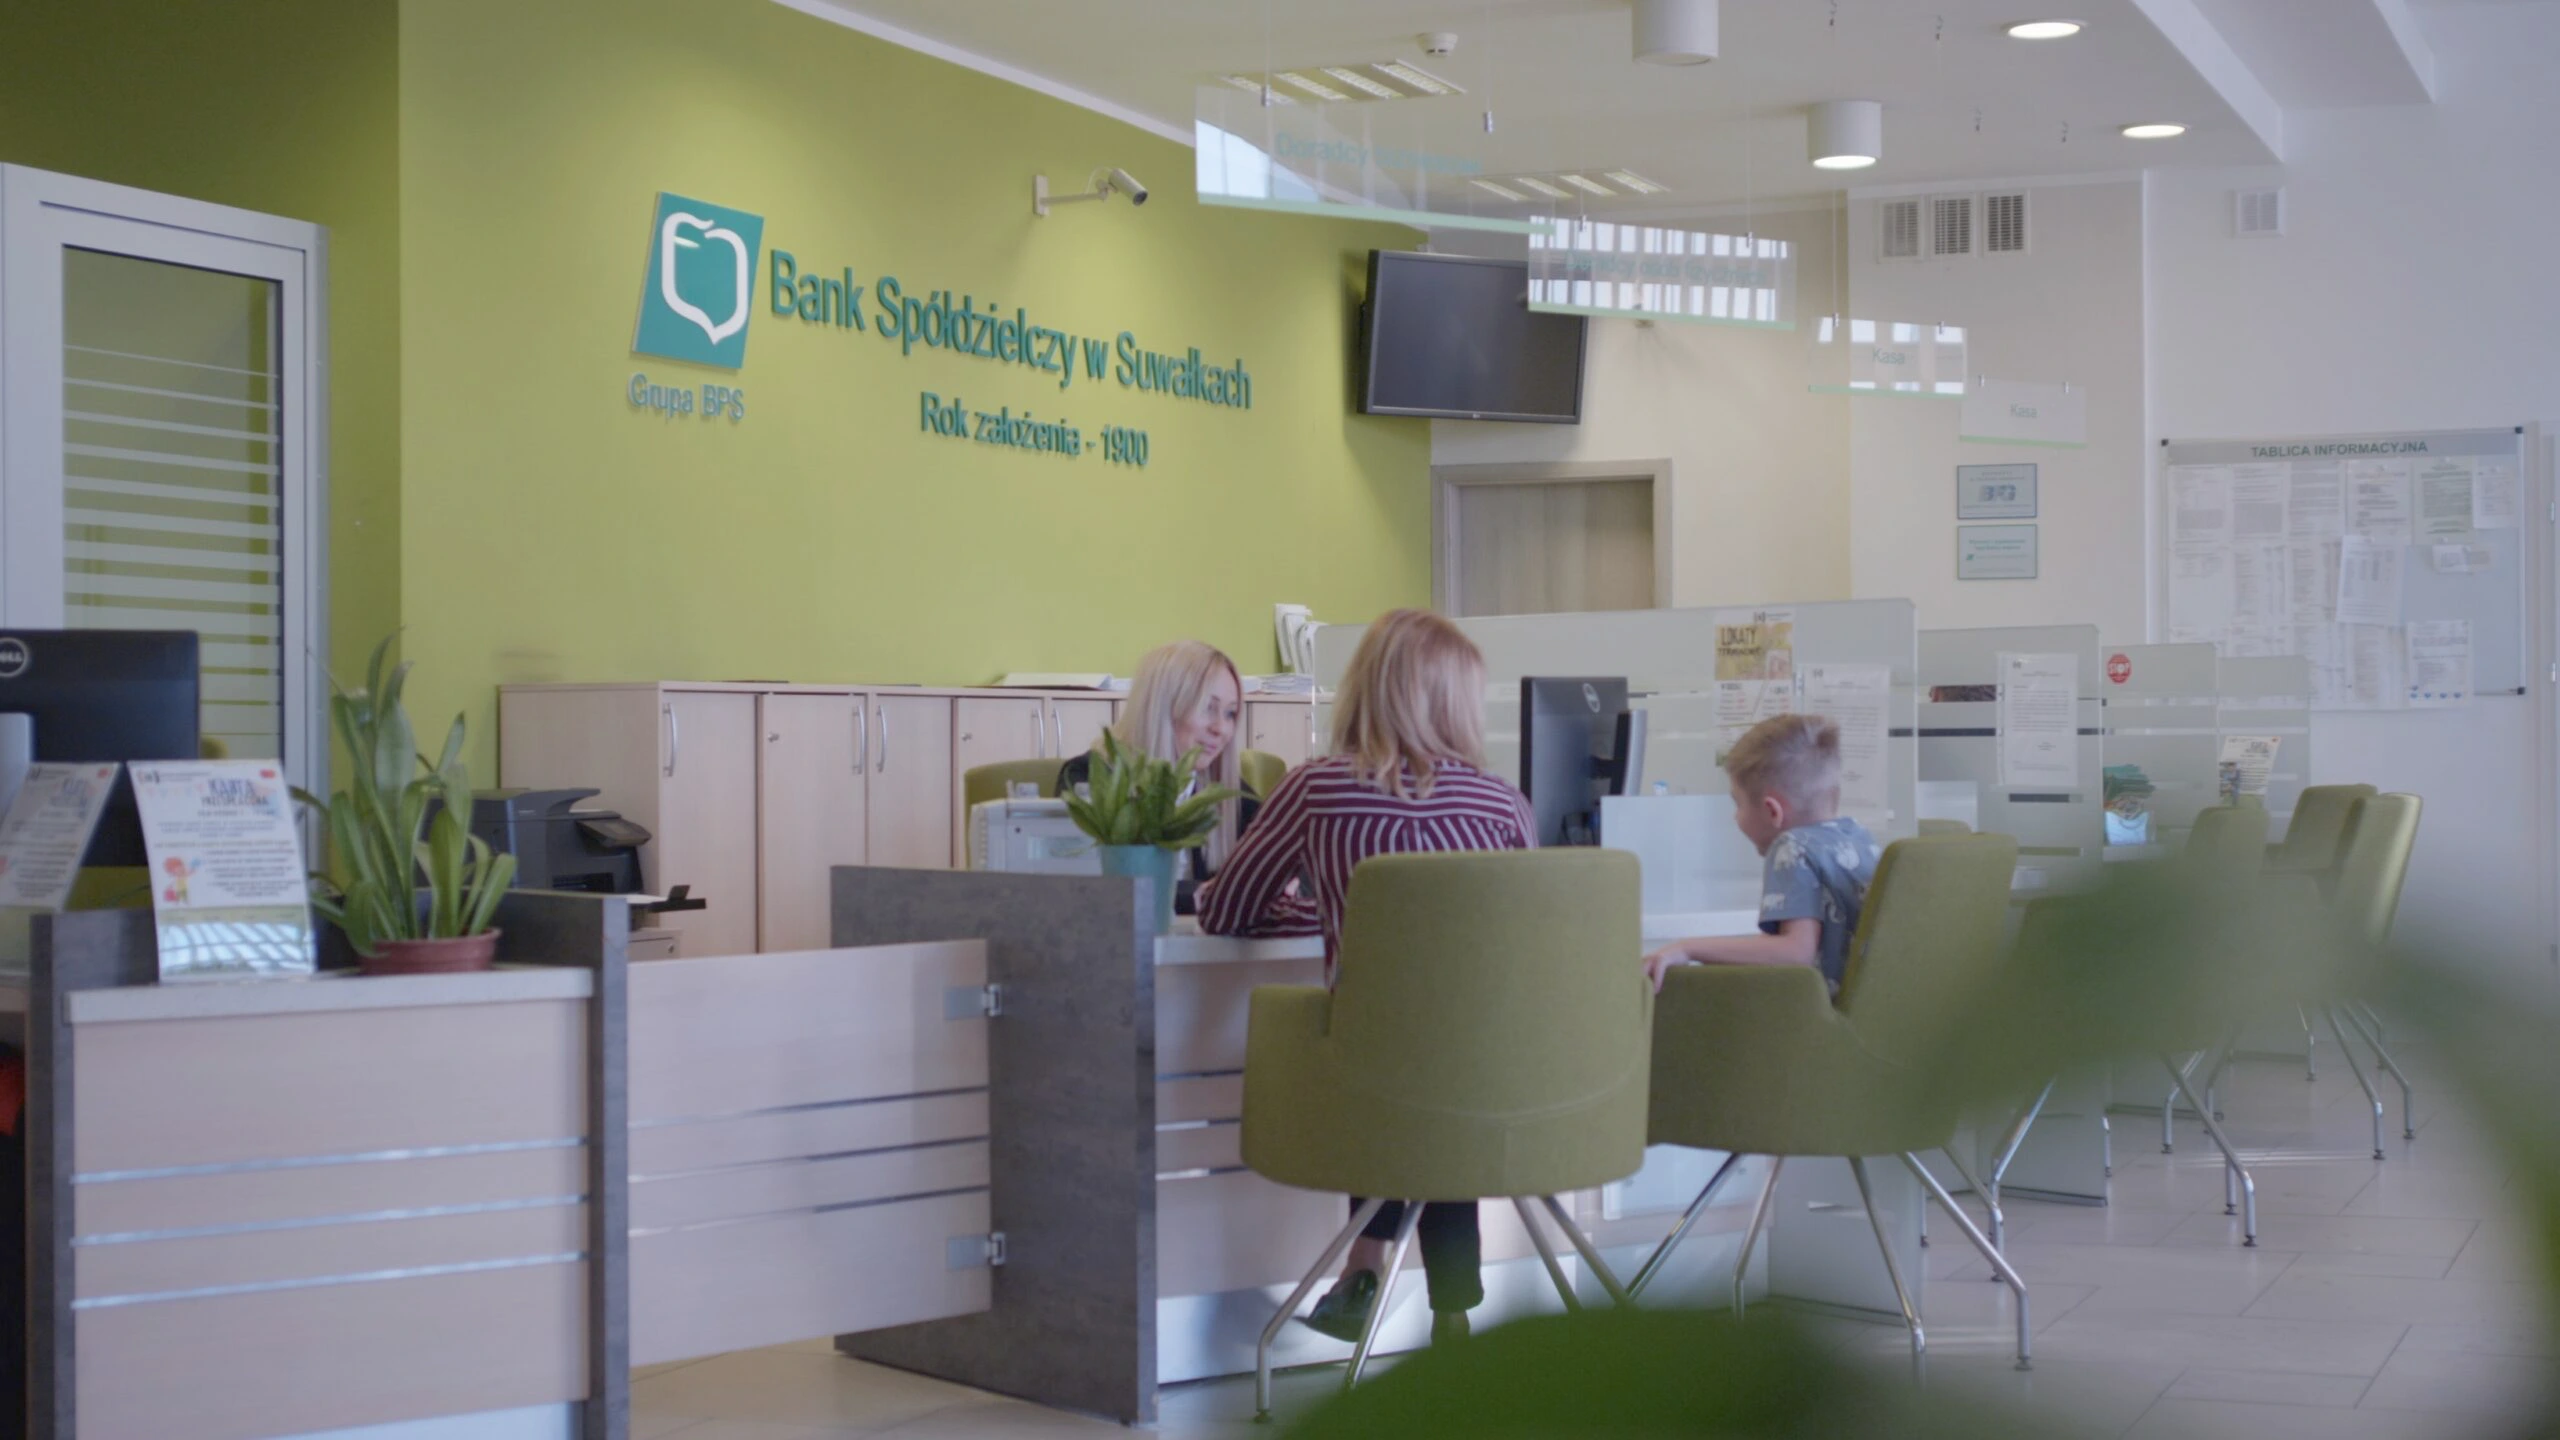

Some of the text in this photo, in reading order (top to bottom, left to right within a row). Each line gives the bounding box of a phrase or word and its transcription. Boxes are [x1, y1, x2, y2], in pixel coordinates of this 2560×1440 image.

[1276, 131, 1368, 166] Doradcy
[770, 248, 1252, 410] Bank Spółdzielczy w Suwałkach
[1872, 347, 1906, 365] Kasa
[629, 372, 745, 421] Grupa BPS
[2010, 403, 2038, 419] Kasa
[920, 391, 969, 439] Rok
[974, 406, 1081, 456] założenia
[1100, 423, 1148, 466] 1900
[2251, 441, 2429, 458] TABLICA INFORMACYJNA
[1720, 627, 1757, 646] LOKATY
[2108, 662, 2130, 674] STOP
